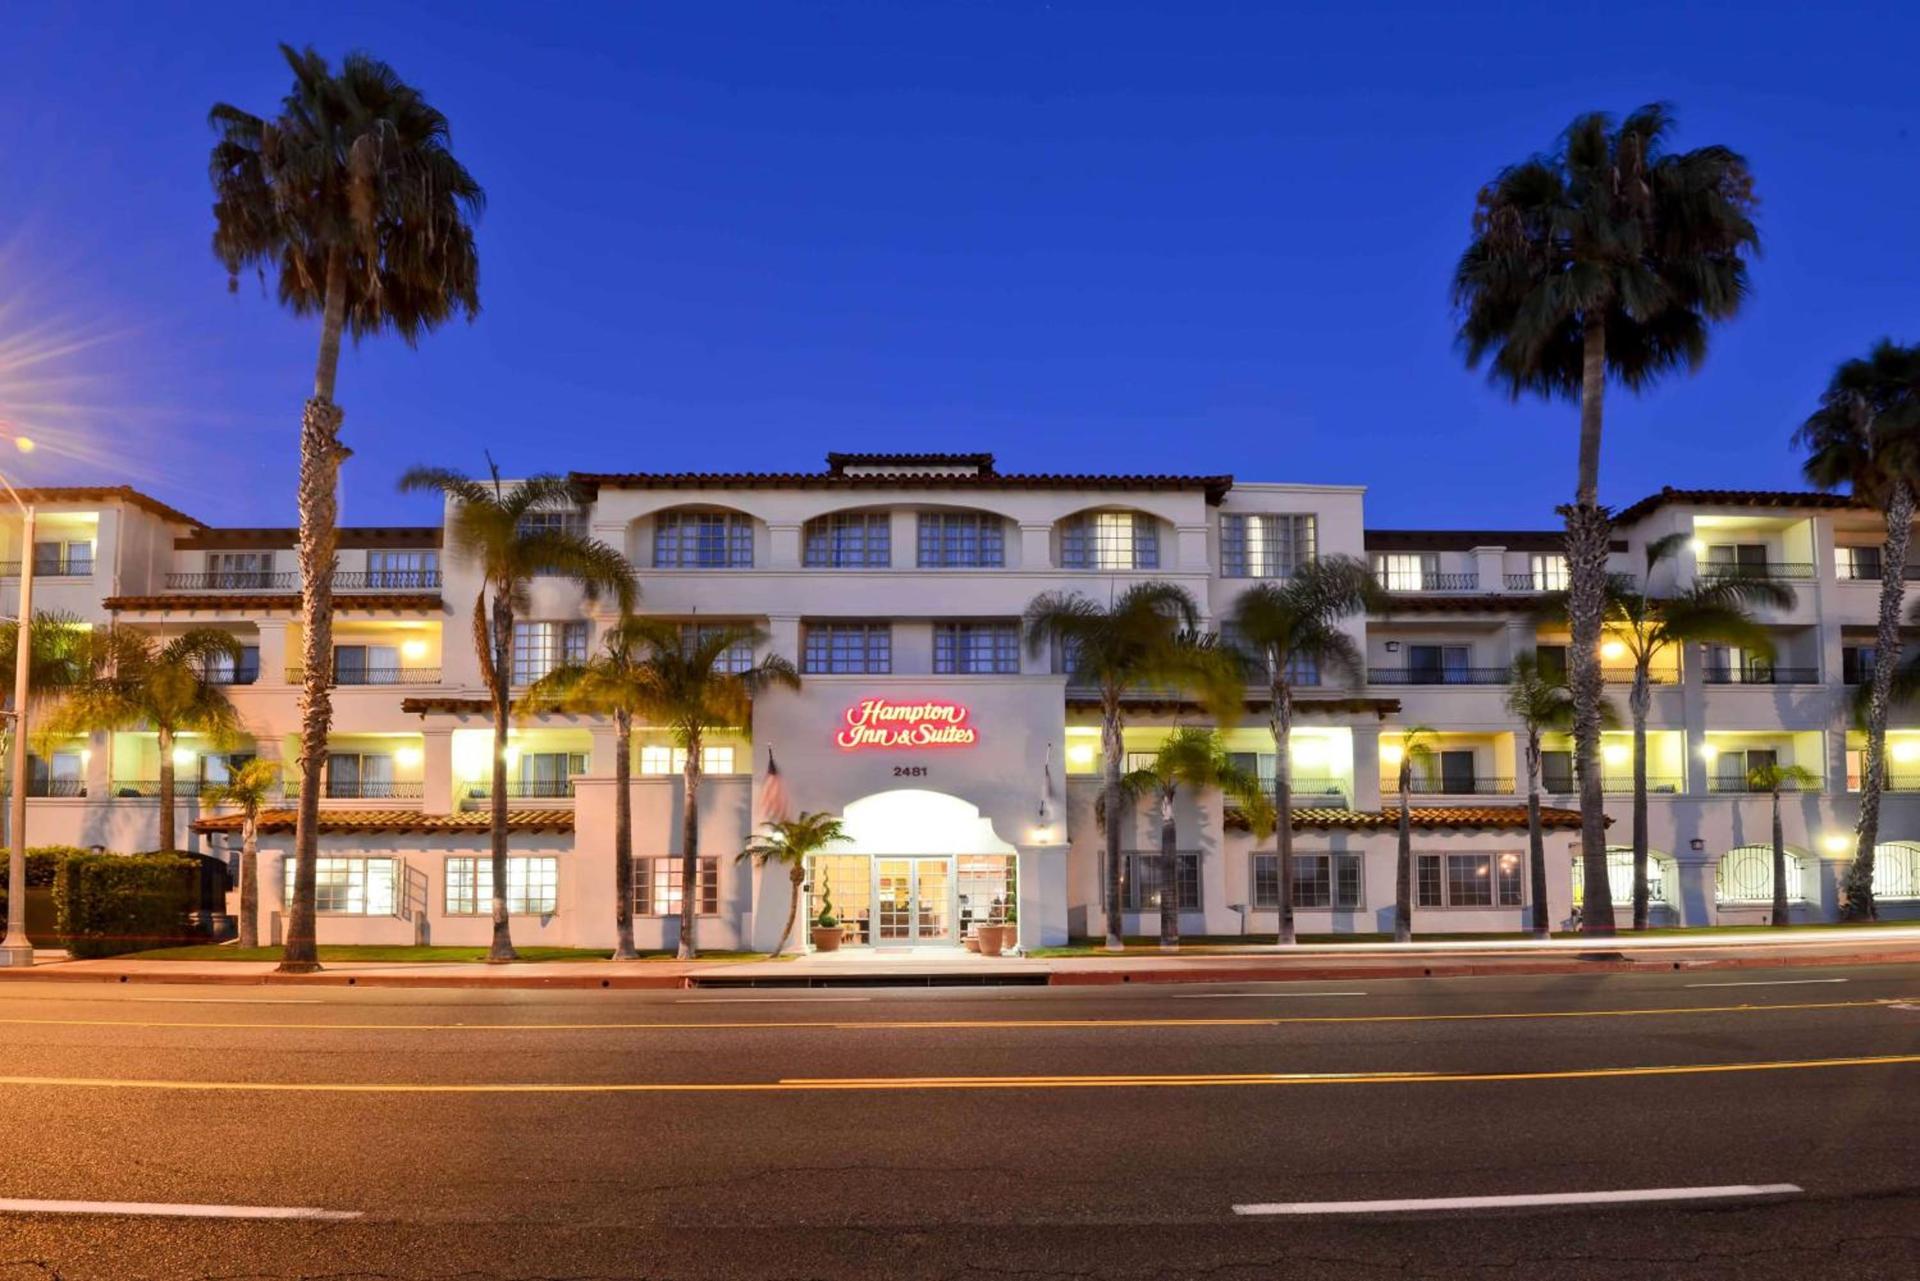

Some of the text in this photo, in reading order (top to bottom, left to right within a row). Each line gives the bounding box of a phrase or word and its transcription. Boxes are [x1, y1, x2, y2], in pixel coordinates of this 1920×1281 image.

[847, 700, 965, 725] Hampton
[838, 724, 974, 747] Inn & Suites
[893, 767, 927, 777] 2481
